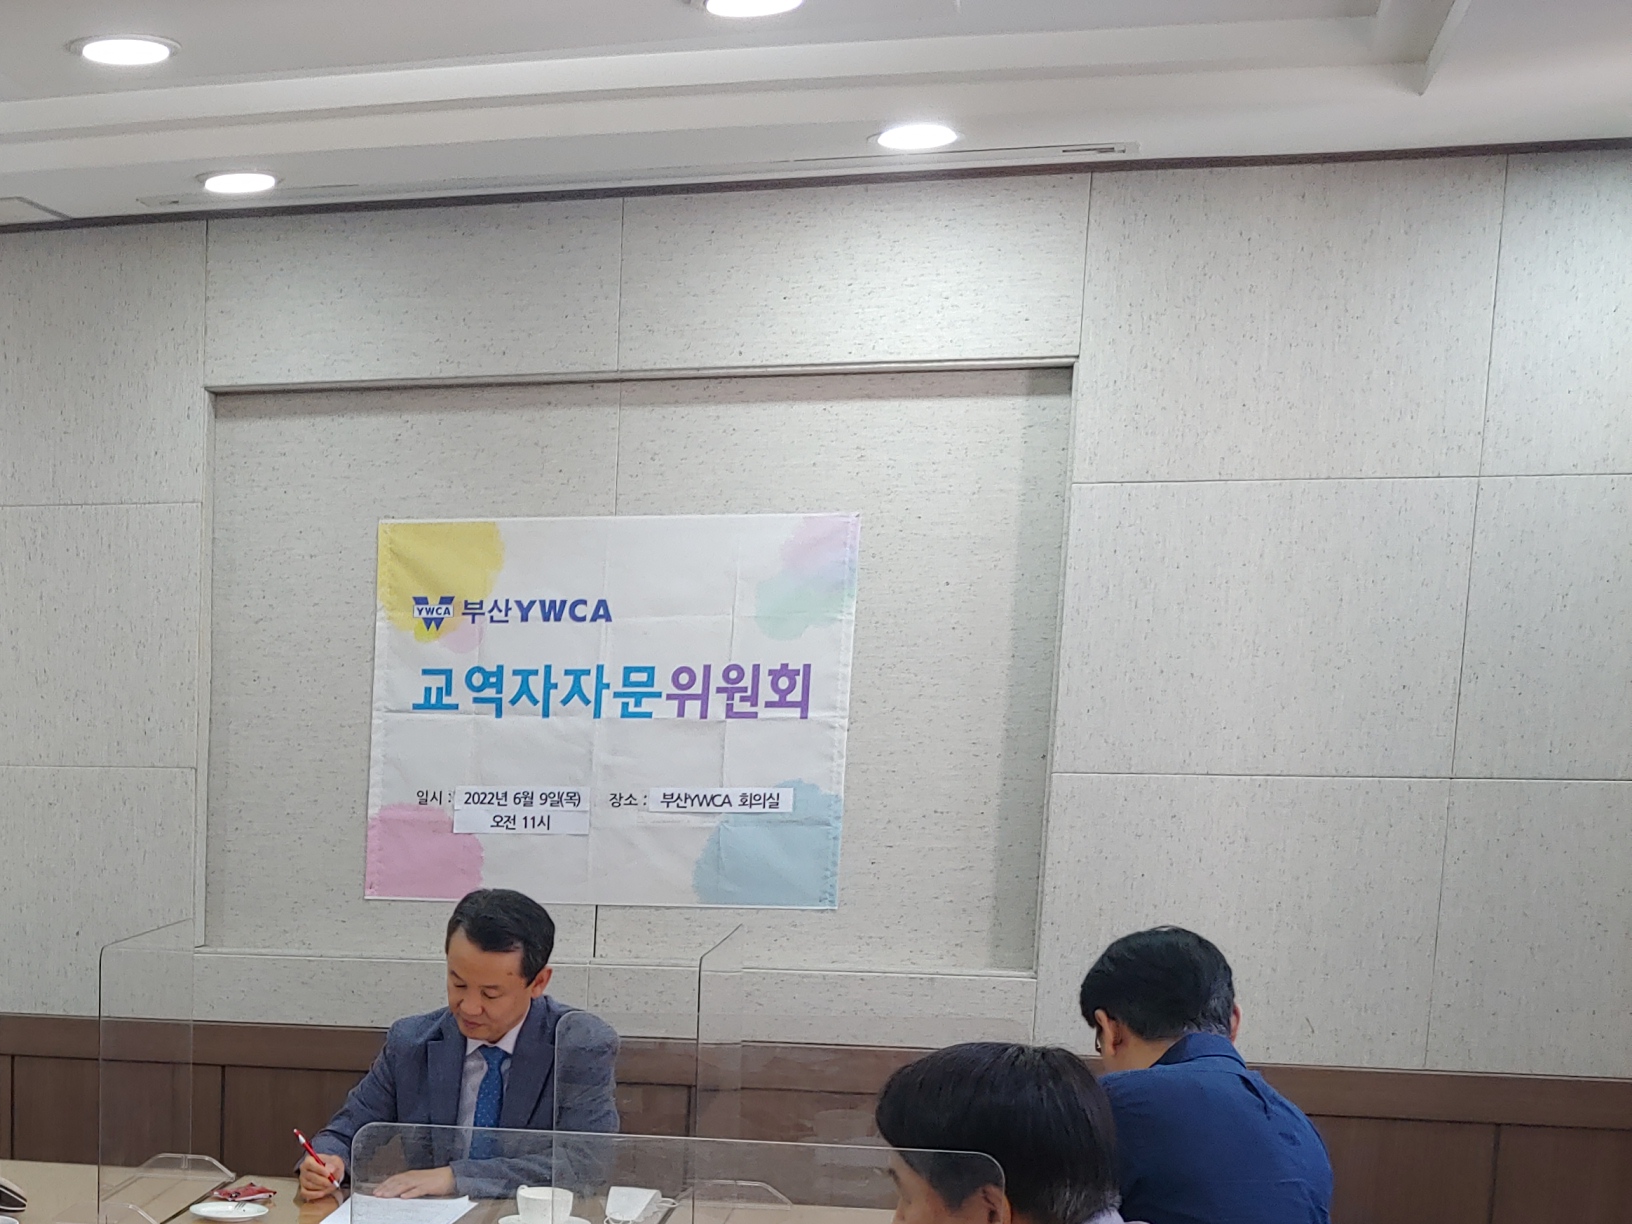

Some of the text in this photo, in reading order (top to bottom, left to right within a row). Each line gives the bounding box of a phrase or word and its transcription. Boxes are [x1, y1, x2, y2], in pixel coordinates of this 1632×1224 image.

[461, 598, 613, 624] 부산YWCA
[411, 662, 812, 720] 교역자자문위원회
[416, 790, 443, 806] 일시
[464, 791, 508, 807] 2022년
[513, 791, 534, 807] 6월
[539, 791, 581, 808] 9일(목)
[608, 792, 638, 808] 장소
[660, 792, 733, 809] 부산YWCA
[738, 792, 780, 809] 회의실
[490, 814, 551, 831] 오전 11시
